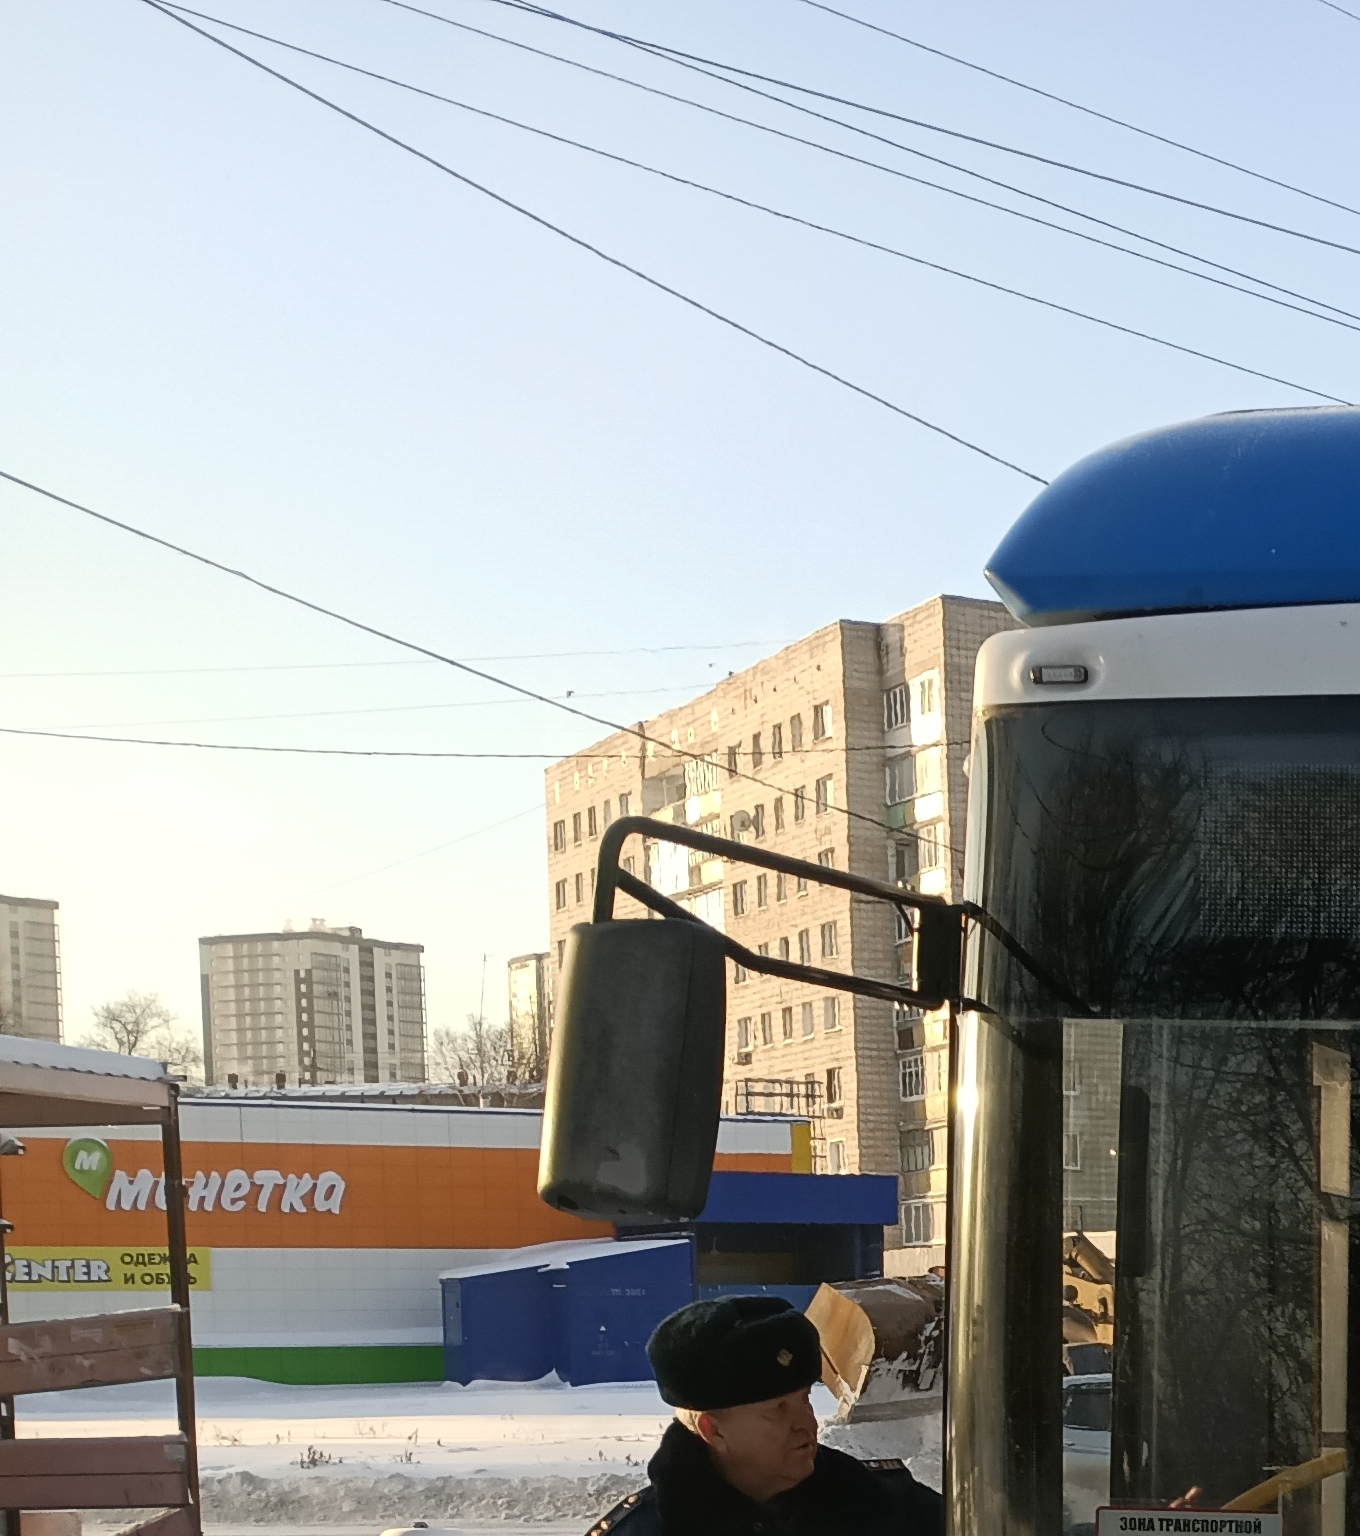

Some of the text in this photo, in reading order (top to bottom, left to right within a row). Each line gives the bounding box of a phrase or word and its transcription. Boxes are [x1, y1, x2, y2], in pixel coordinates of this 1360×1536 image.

[120, 1252, 199, 1267] ОДЕЖА
[124, 1272, 197, 1285] И ОБЬ
[1119, 1516, 1262, 1534] ЗОНА ТРАНСПОРТНОЙ
